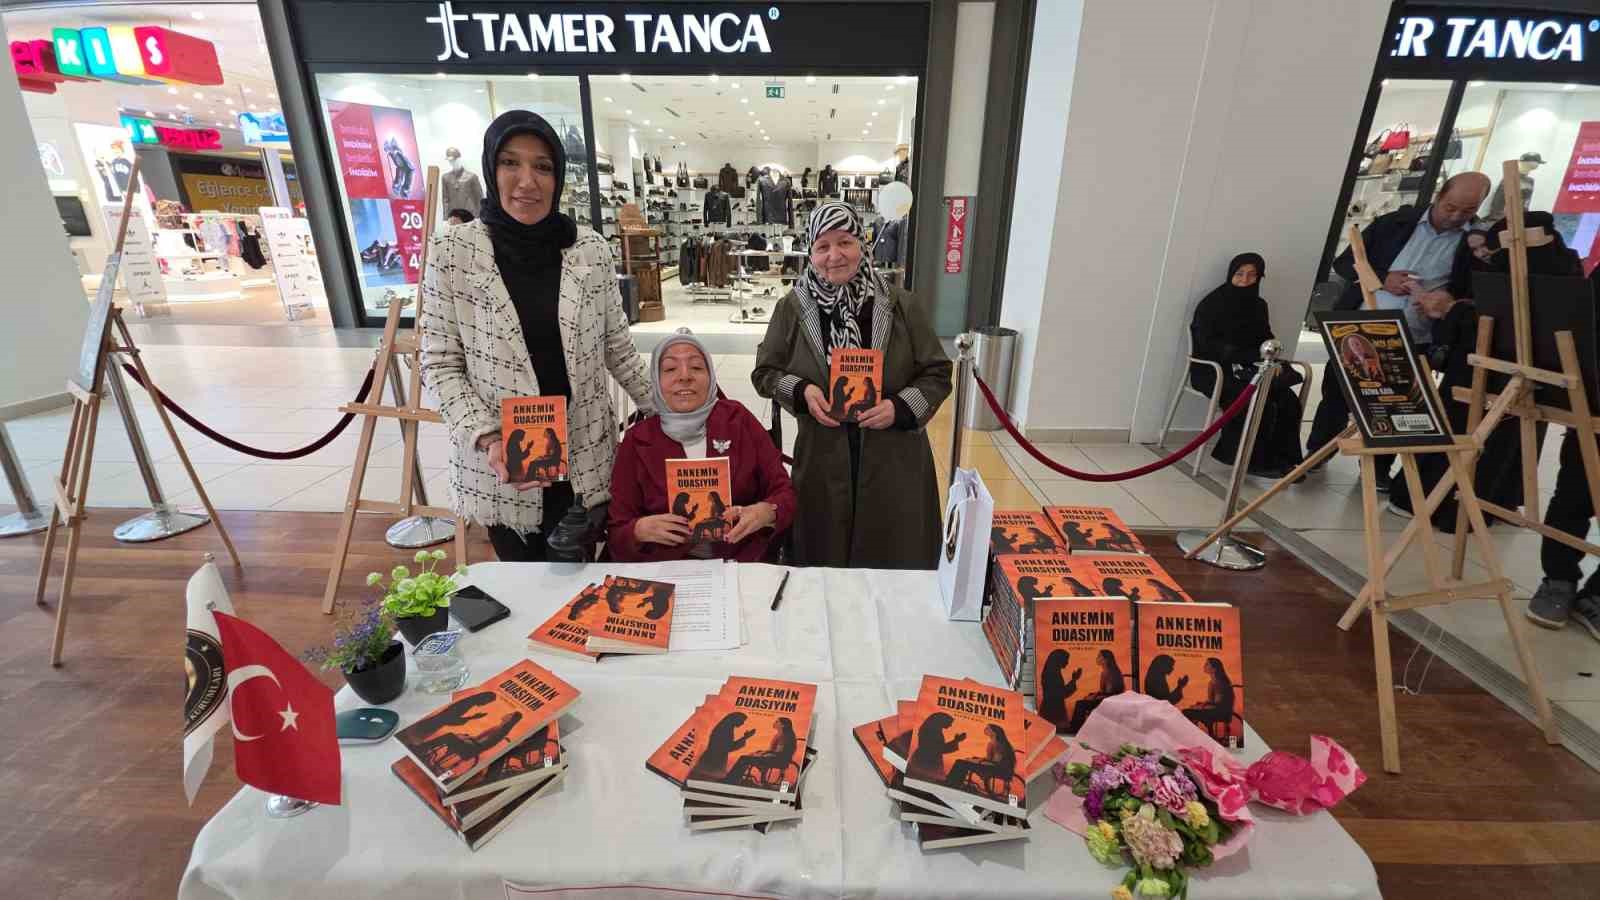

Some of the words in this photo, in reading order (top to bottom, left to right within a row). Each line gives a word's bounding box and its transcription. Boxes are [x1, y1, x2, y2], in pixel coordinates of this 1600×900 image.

[472, 13, 616, 53] TAMER
[625, 13, 772, 53] TANCA
[1446, 18, 1585, 62] TANCA
[56, 36, 163, 66] KIS
[400, 212, 423, 229] 20
[409, 252, 422, 270] 4
[513, 403, 555, 414] ANNEMİN
[513, 414, 556, 425] DUASIYIM
[677, 467, 719, 477] ANNEMİN
[677, 478, 719, 488] DUASIYIM
[606, 615, 657, 631] DUASIYIM
[1051, 609, 1115, 625] ANNEMİN
[1155, 615, 1222, 633] ANNEMİN
[1052, 628, 1115, 642] DUASIYIM
[1156, 632, 1223, 650] DUASIYIM
[513, 670, 560, 701] ANNEMİN
[738, 685, 800, 701] ANNEMİN
[499, 679, 545, 712] DUASIYIM
[938, 685, 1006, 708] ANNEMİN
[735, 696, 797, 713] DUASIYIM
[937, 696, 1006, 720] DUASIYIM
